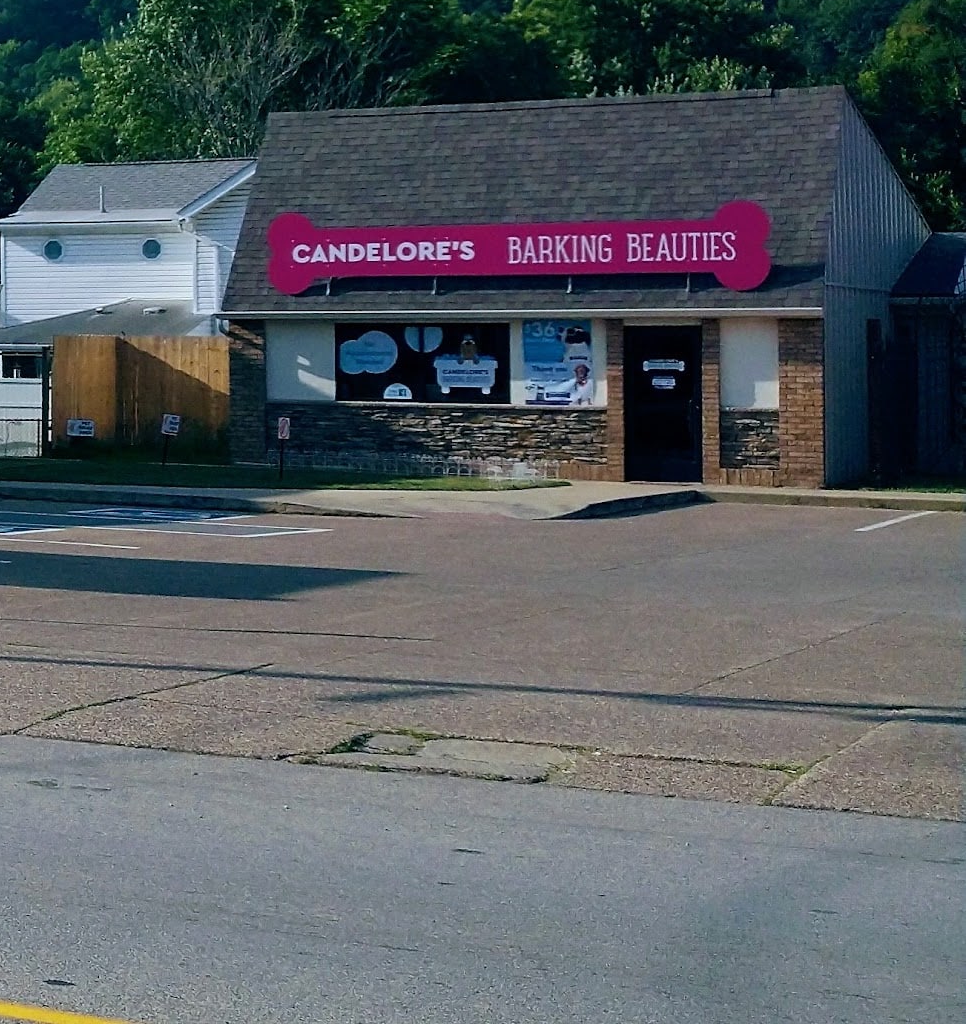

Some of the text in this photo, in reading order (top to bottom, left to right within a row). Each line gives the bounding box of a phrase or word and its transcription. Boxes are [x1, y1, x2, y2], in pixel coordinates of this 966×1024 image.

[292, 231, 737, 264] CANDELORE'S BARKING BEAUTIES
